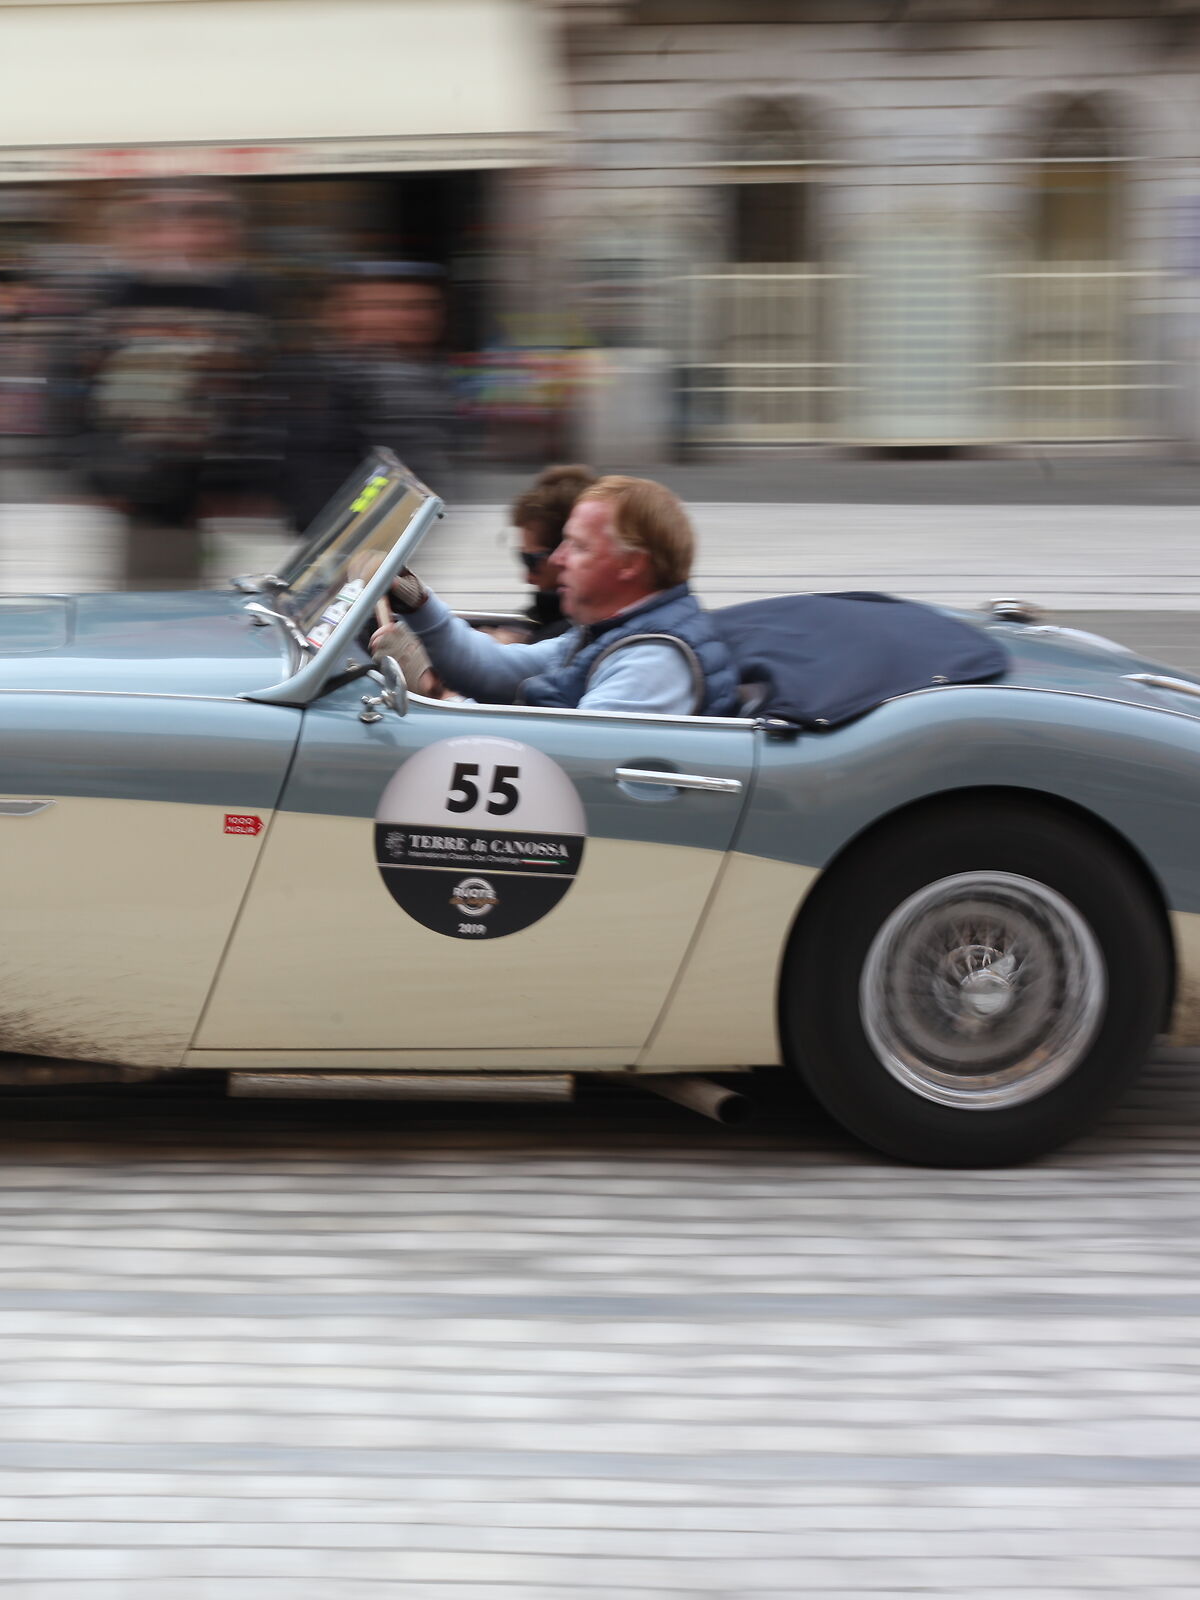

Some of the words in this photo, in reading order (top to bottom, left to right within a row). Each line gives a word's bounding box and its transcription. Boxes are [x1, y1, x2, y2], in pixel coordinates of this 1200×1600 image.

[445, 762, 520, 816] 55
[408, 834, 469, 851] TERRE
[470, 838, 488, 852] di
[490, 839, 569, 858] CANOSSA
[457, 923, 487, 935] 2019
